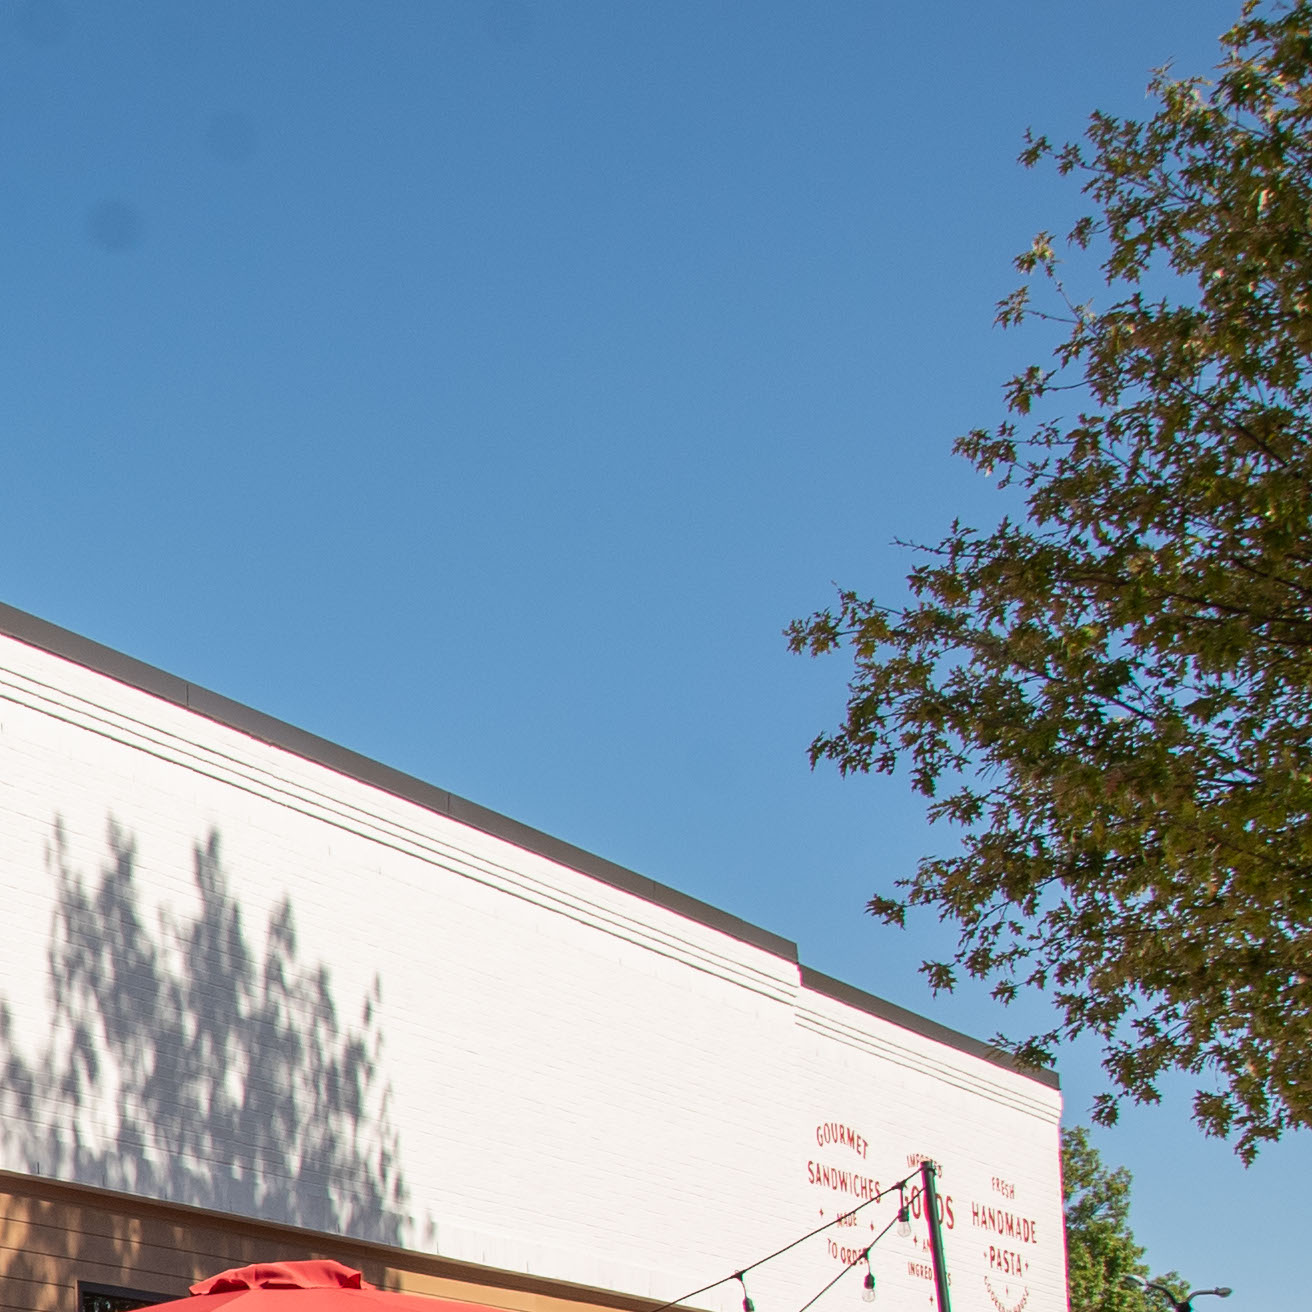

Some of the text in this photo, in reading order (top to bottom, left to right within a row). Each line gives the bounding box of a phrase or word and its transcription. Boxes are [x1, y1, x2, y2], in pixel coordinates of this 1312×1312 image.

[816, 1122, 868, 1159] GOURMET
[807, 1160, 881, 1204] SANDWICHES
[991, 1176, 1015, 1199] FRESH
[972, 1201, 1037, 1244] HANDMADE
[827, 1238, 838, 1259] TO
[989, 1245, 1023, 1277] PASTA
